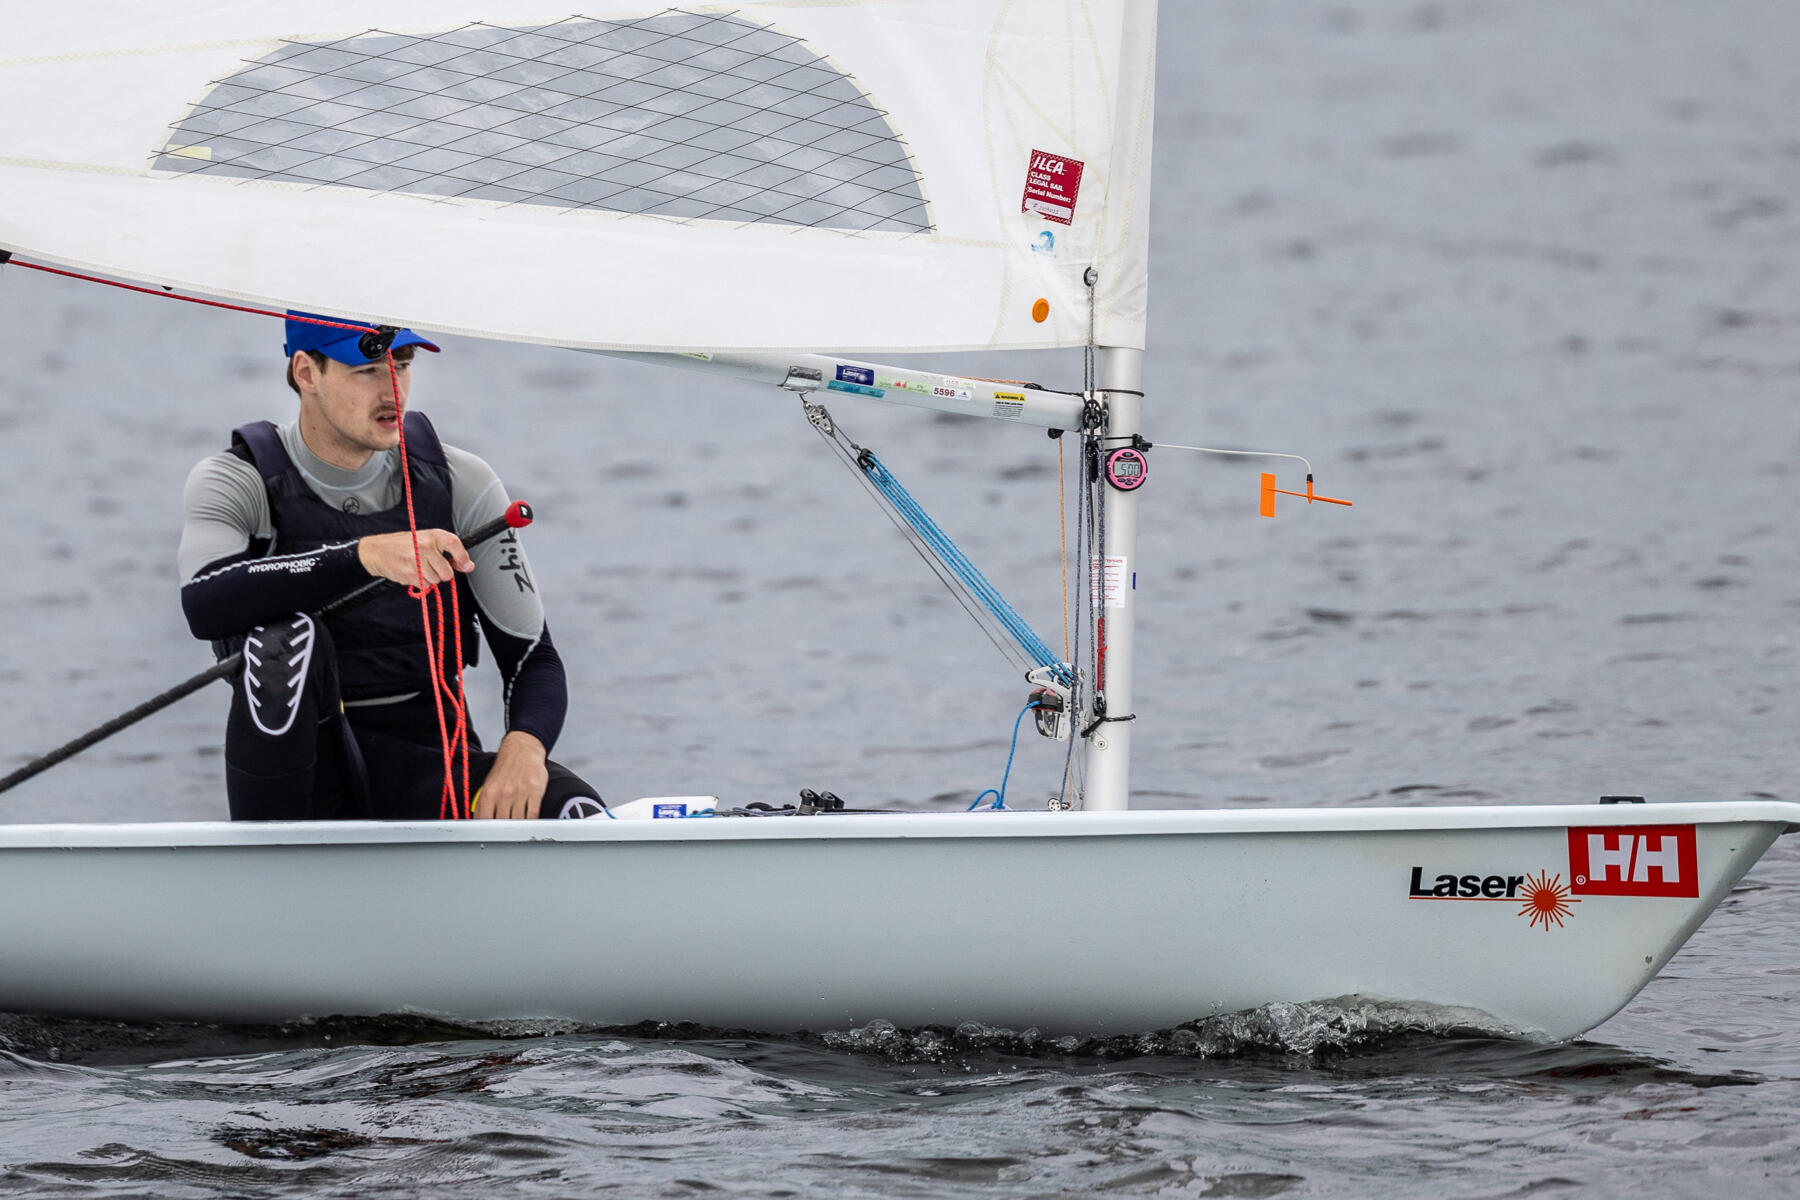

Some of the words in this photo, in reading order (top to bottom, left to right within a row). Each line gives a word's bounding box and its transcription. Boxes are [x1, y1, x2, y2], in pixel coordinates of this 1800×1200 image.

[1033, 156, 1064, 175] ILCA
[1031, 171, 1051, 181] CLASS
[1028, 187, 1045, 196] Serial
[1029, 178, 1048, 188] LEGAL
[1050, 183, 1063, 192] SAIL
[933, 387, 956, 398] 5596
[248, 558, 316, 573] HYDROPHOBIC
[1409, 866, 1524, 898] Laser
